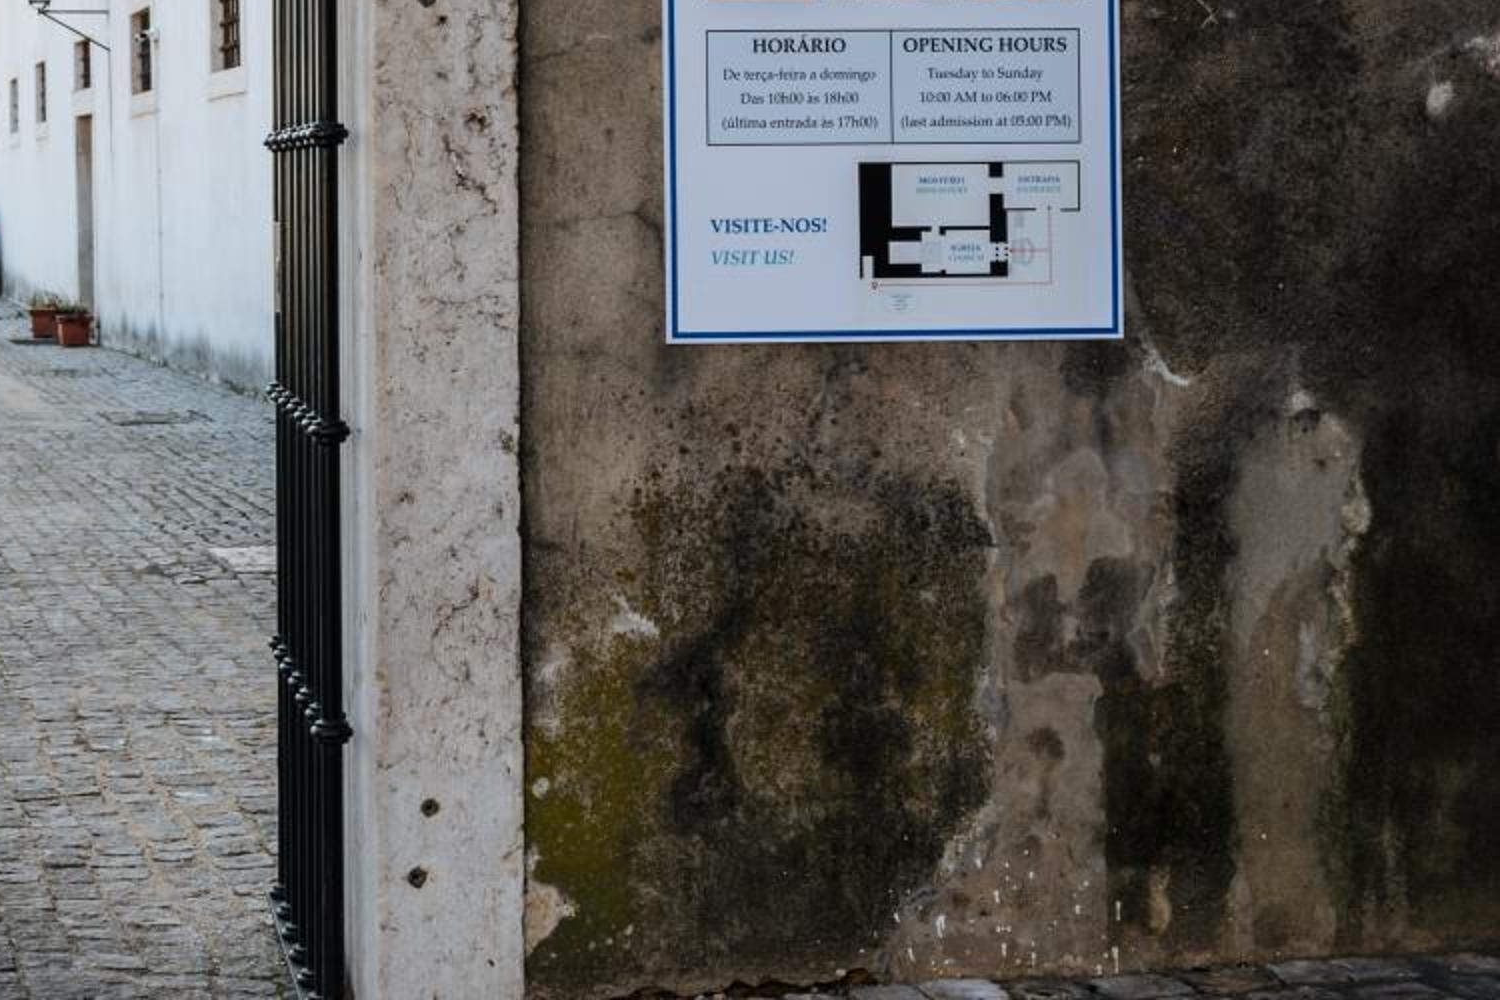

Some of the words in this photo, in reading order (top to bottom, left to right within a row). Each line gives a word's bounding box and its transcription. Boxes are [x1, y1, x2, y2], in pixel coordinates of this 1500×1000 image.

[752, 34, 847, 54] HORÁRIO
[903, 37, 994, 54] OPENING
[998, 36, 1067, 53] HOURS
[723, 67, 741, 81] De
[743, 67, 807, 83] terça-feira
[809, 71, 817, 81] a
[819, 67, 877, 83] domingo
[928, 67, 977, 82] Tuesday
[981, 68, 994, 80] to
[997, 67, 1044, 82] Sunday
[740, 92, 765, 105] Das
[768, 92, 804, 104] 10h00
[824, 91, 859, 104] 18h00
[920, 91, 951, 104] 10:00
[954, 91, 977, 103] AM
[981, 91, 993, 103] to
[995, 90, 1029, 103] 06:00
[1031, 90, 1053, 103] PM
[721, 115, 767, 131] (última
[769, 116, 817, 129] entrada
[901, 115, 927, 129] (last
[929, 115, 993, 128] admission
[995, 116, 1007, 128] at
[1045, 114, 1072, 129] PM)
[710, 217, 828, 234] VISITE-NOS!
[711, 249, 760, 266] VISIT
[763, 248, 795, 266] US!
